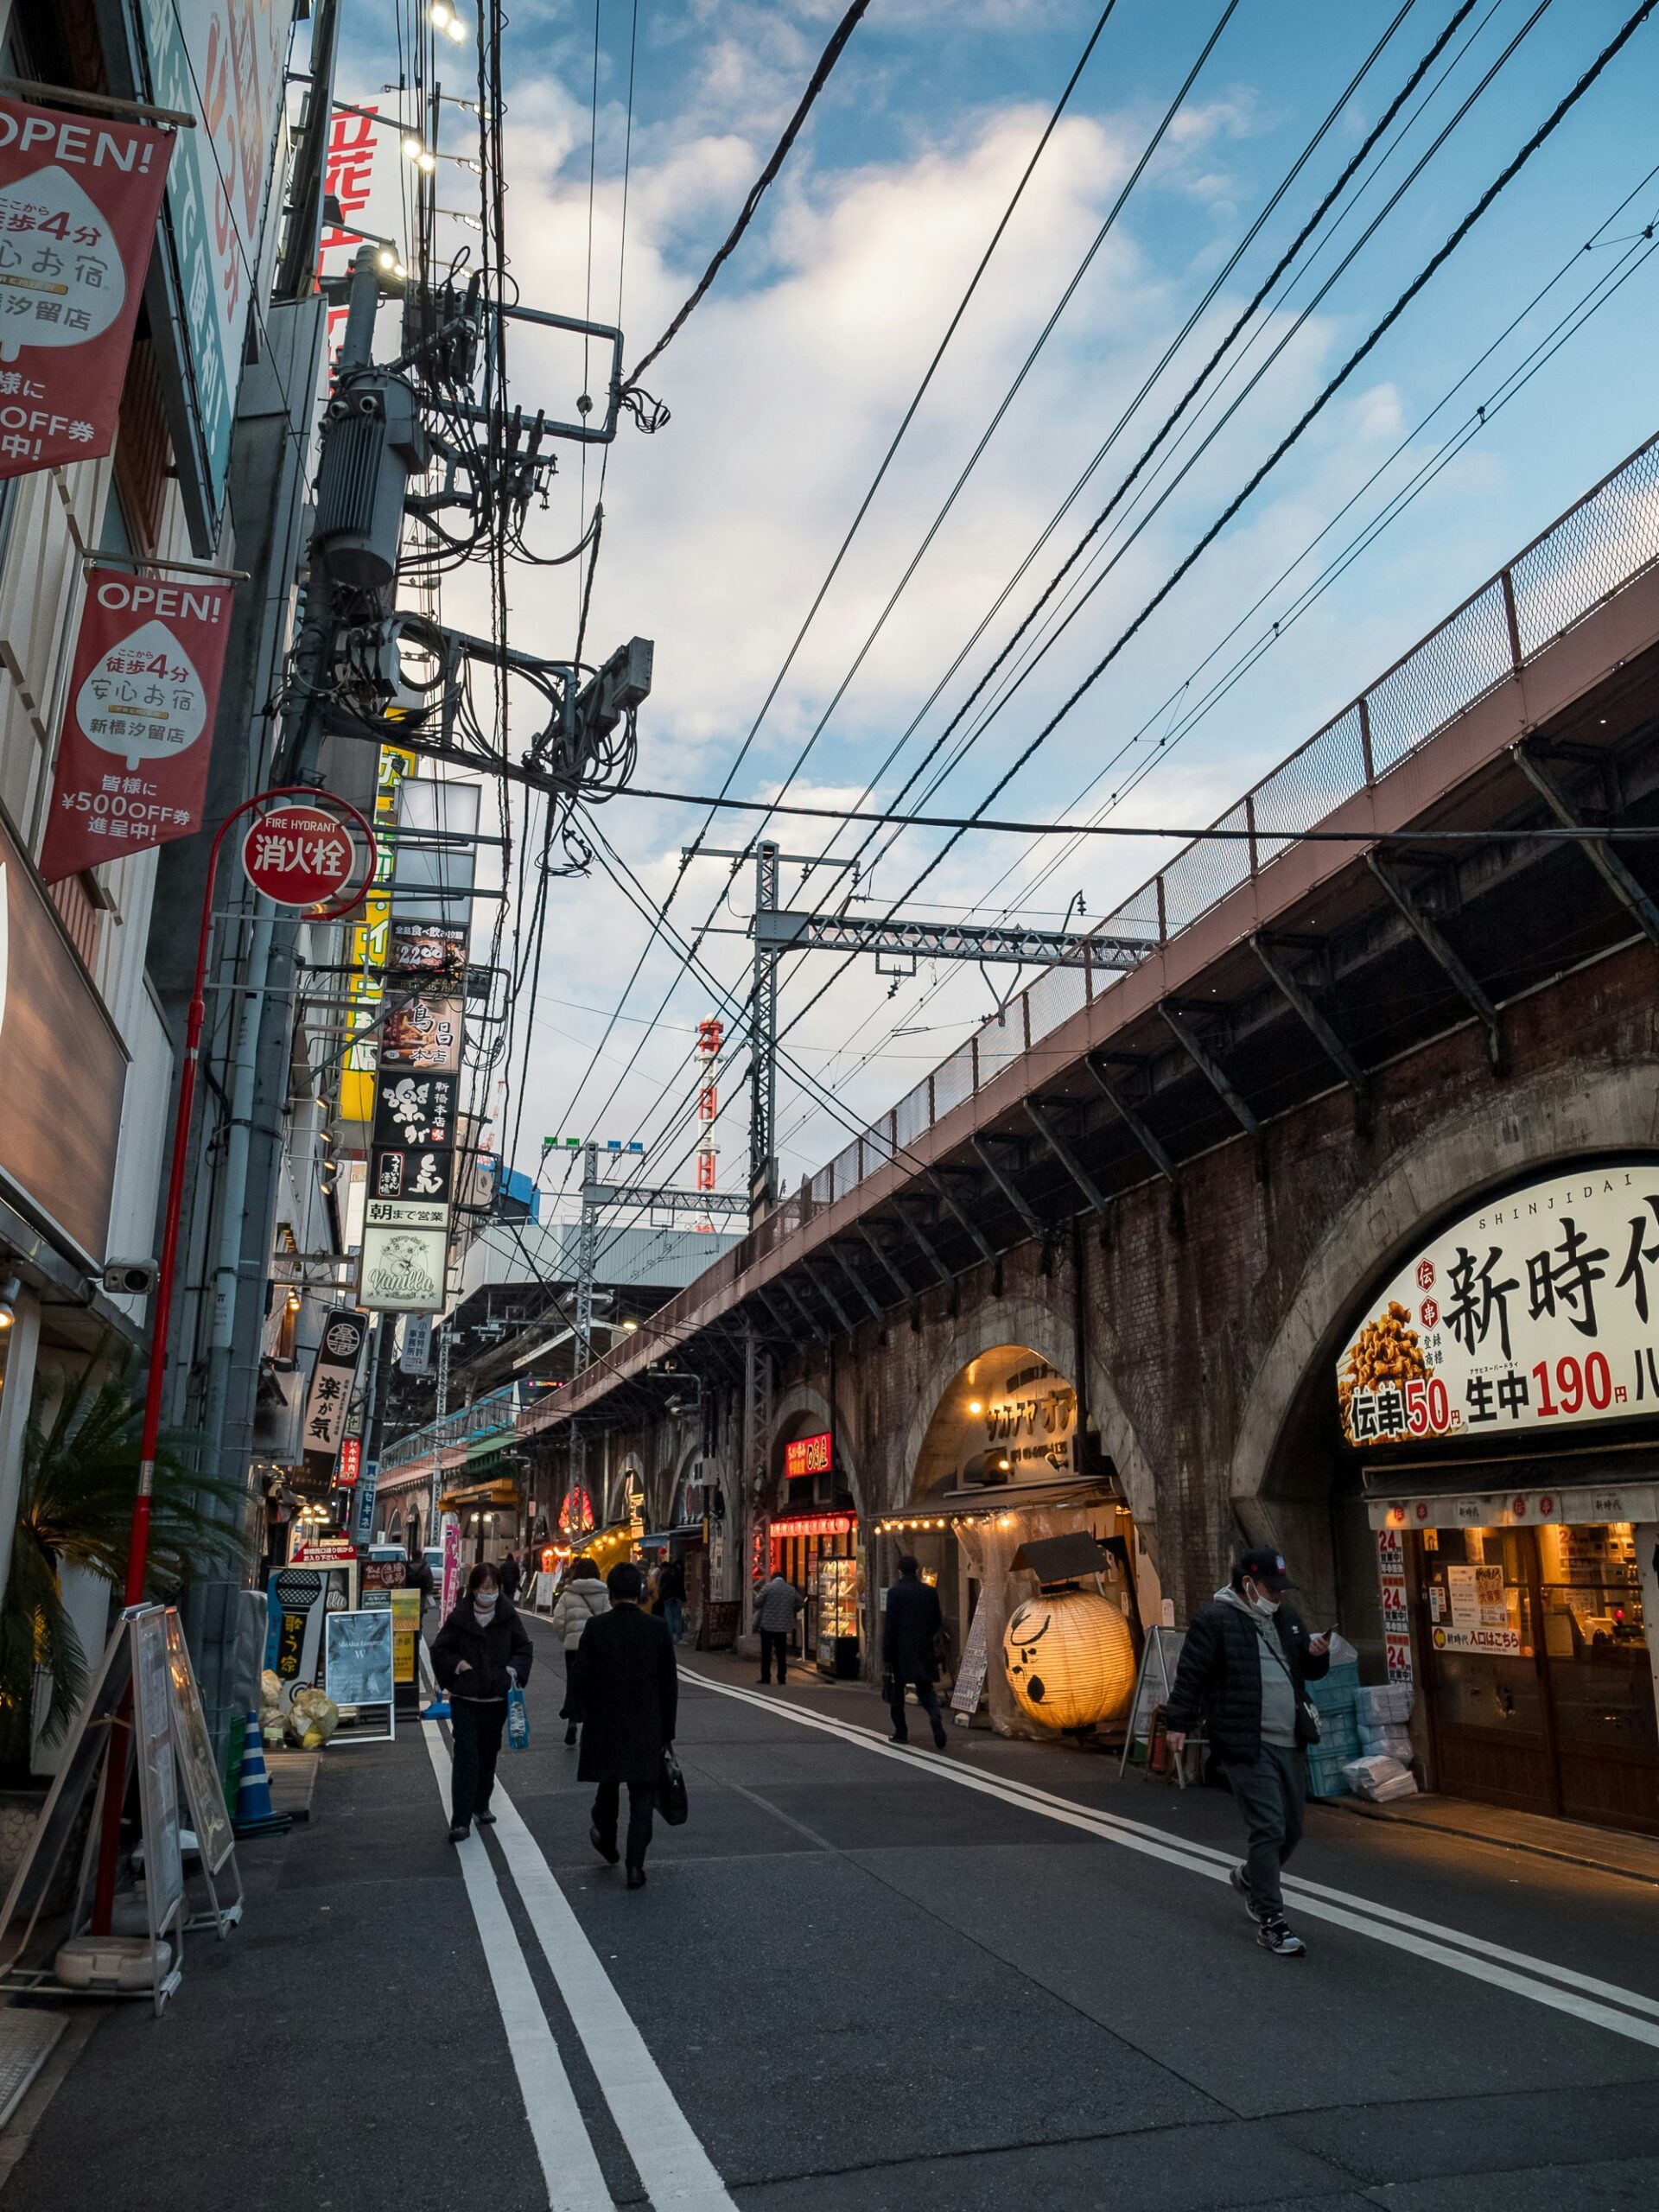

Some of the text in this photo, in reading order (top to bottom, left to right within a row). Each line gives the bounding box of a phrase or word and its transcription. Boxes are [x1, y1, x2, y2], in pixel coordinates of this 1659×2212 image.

[0, 211, 102, 247] 歩4分
[0, 292, 92, 332] 汐留店
[0, 406, 95, 442] OFF券
[97, 582, 222, 624] OPEN!
[105, 653, 190, 683] 徒歩4分
[118, 648, 154, 659] ここから
[91, 678, 195, 712] 安心お宿
[89, 718, 185, 745] 新橋汐留店
[102, 774, 157, 797] 皆様に
[87, 815, 157, 842] 進呈中!
[265, 817, 338, 834] FIRE HYDRANT
[253, 834, 346, 877] 消火栓
[432, 1081, 450, 1128] 新橋本店
[370, 1203, 443, 1222] 朝まで営業
[1478, 1173, 1633, 1230] SHINJIDAI
[368, 1268, 435, 1293] Vanilla
[1470, 1630, 1519, 1648] 入口はこちら
